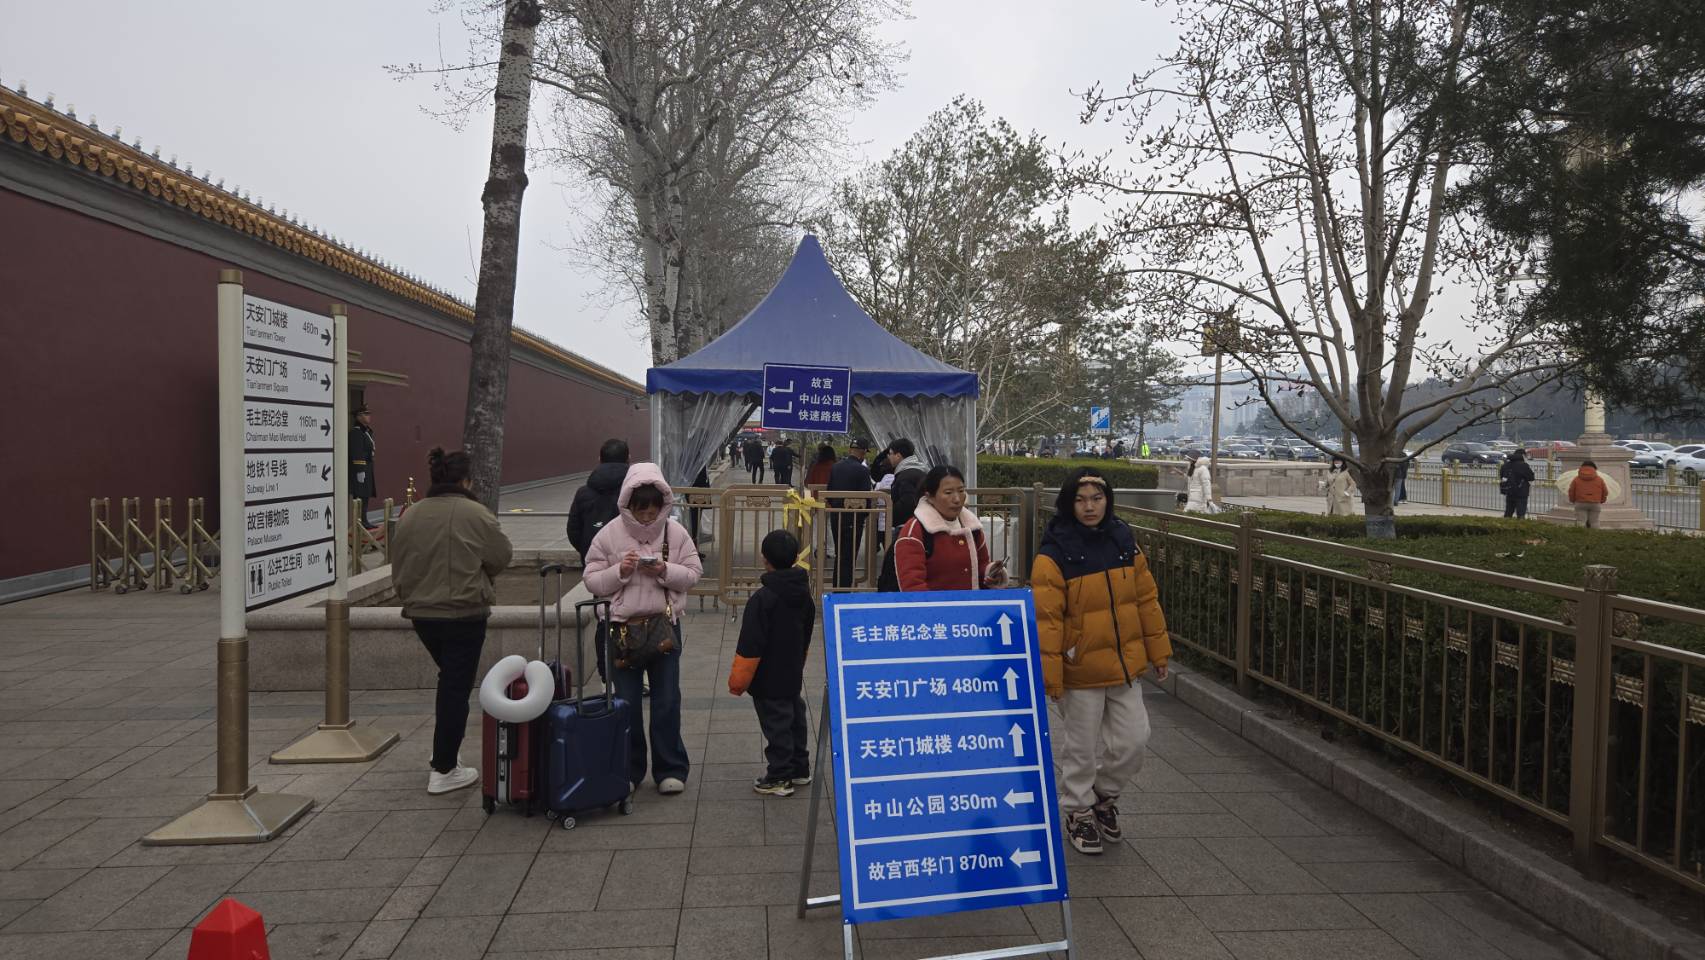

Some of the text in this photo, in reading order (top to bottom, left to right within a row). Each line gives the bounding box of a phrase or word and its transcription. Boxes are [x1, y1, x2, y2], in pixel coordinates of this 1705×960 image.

[246, 302, 288, 329] 天安门城楼
[246, 355, 318, 382] 天安门广场 510m
[811, 377, 833, 389] 故宫
[799, 393, 843, 406] 中山公园
[246, 408, 318, 428] 毛主席纪念堂 1160m
[798, 409, 842, 423] 快速路线
[246, 459, 317, 478] 地铁1号线 10m
[246, 484, 265, 495] Subway
[265, 482, 275, 492] Line
[247, 507, 290, 531] 故宫博物院
[267, 552, 303, 576] 公共卫生间
[851, 623, 993, 643] 毛主席纪念堂 550m
[856, 678, 999, 700] 天安门广场 480m
[860, 734, 1005, 760] 天安门城楼 430m
[864, 794, 998, 820] 中山公园 350m
[868, 854, 1004, 881] 故宫西华门 870m
